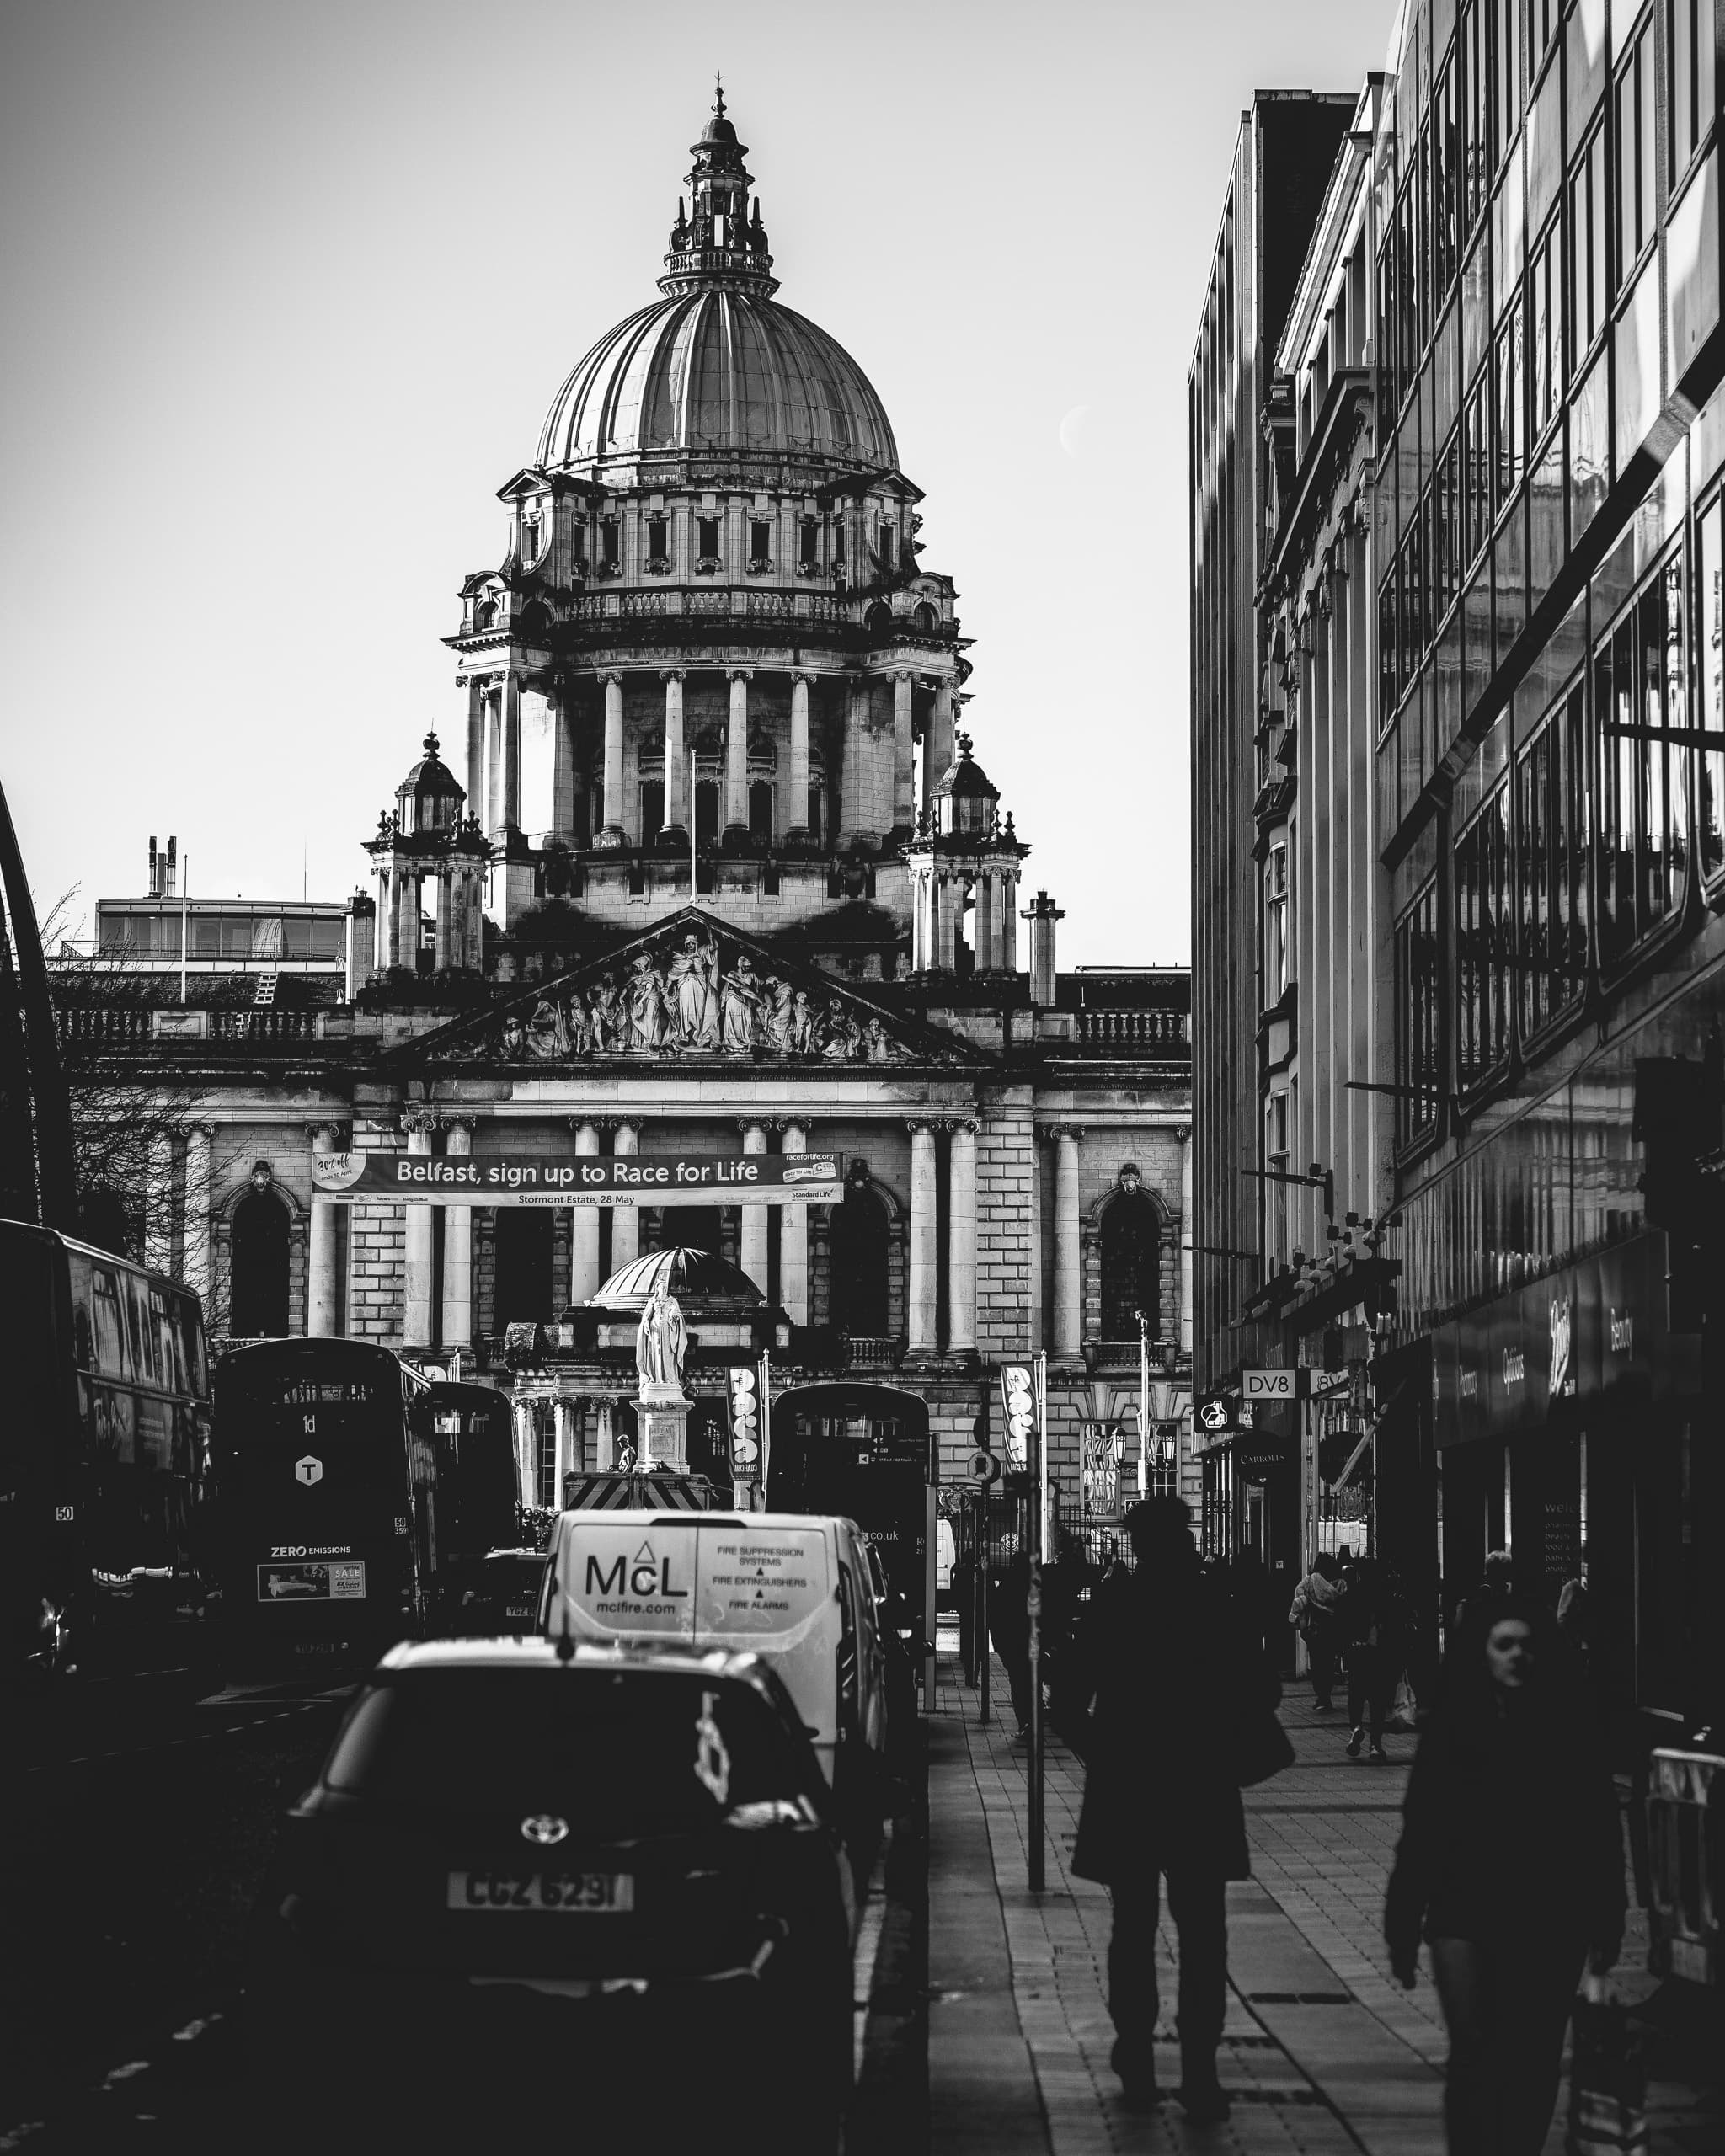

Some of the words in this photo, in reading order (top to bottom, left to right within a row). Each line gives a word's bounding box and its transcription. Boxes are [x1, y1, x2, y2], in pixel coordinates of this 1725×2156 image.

[318, 1157, 335, 1171] 30%
[337, 1153, 350, 1169] off
[398, 1161, 482, 1184] Belfast,
[489, 1161, 537, 1187] sign
[544, 1166, 574, 1186] up
[581, 1164, 606, 1182] to
[613, 1162, 669, 1182] Race
[676, 1161, 710, 1181] for
[717, 1161, 759, 1181] Life
[518, 1195, 563, 1204] Stormont
[567, 1195, 598, 1204] Estate,
[600, 1195, 612, 1203] 28
[615, 1195, 635, 1206] May
[1249, 1376, 1289, 1393] DV8
[303, 1415, 315, 1433] 1d
[302, 1464, 317, 1481] T
[58, 1508, 72, 1520] 50
[270, 1546, 307, 1557] ZERO
[308, 1546, 351, 1555] EMISSIONS
[718, 1546, 737, 1556] FIRE
[740, 1547, 804, 1557] SUPPRESSION
[740, 1557, 782, 1566] SYSTEMS
[585, 1556, 688, 1597] McL
[713, 1577, 732, 1585] FIRE
[734, 1577, 807, 1588] EXTINGUISHERS
[596, 1601, 676, 1614] mclfire.com
[729, 1601, 749, 1609] FIRE
[751, 1601, 789, 1610] ALARMS
